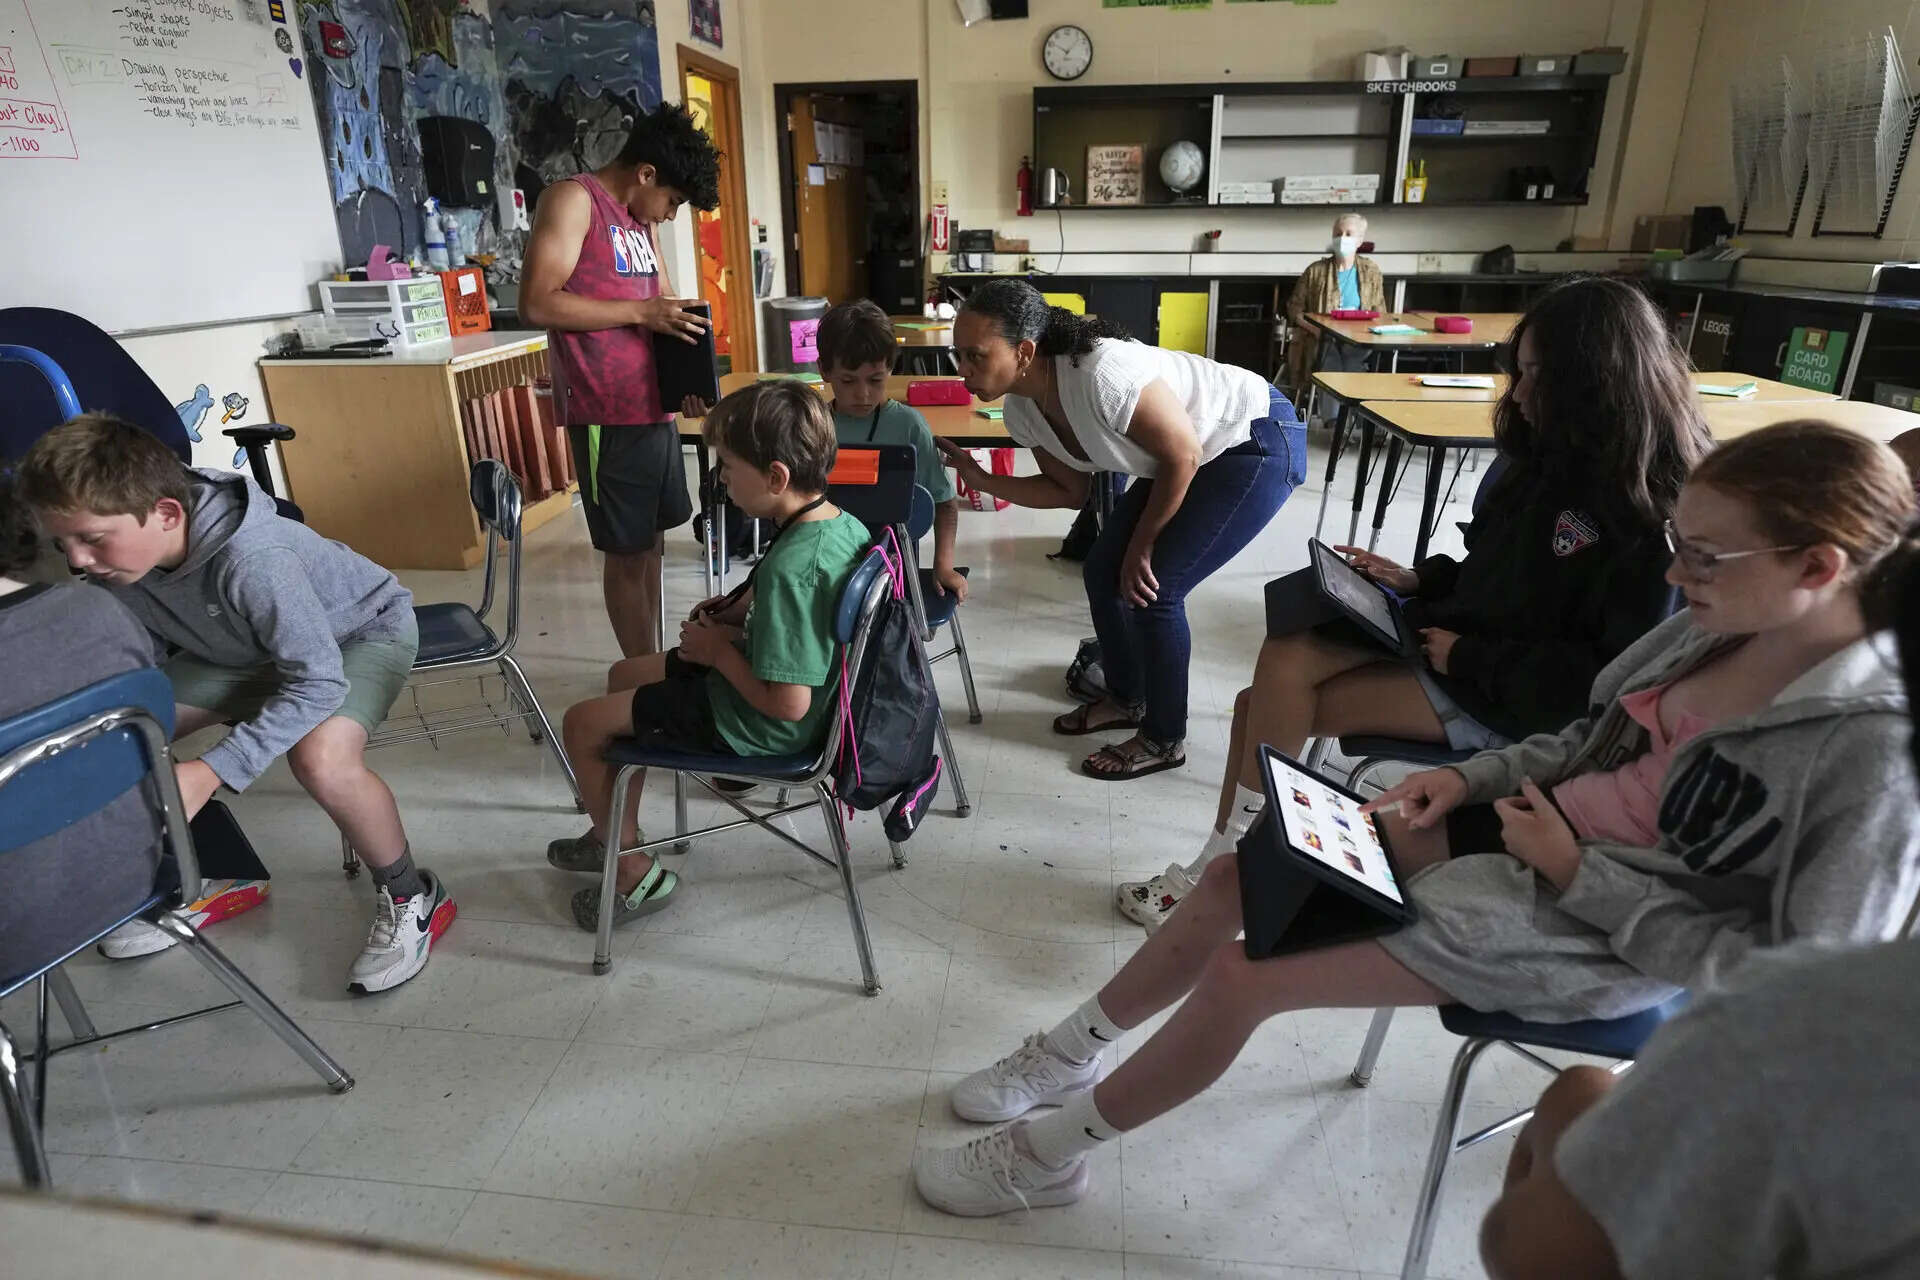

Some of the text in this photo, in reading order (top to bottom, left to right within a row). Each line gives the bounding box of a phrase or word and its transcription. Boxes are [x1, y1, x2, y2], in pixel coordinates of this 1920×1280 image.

[121, 58, 230, 86] Drawing perspective
[1366, 81, 1457, 94] SKETCHBOOKS
[25, 106, 59, 134] Clay
[625, 230, 659, 273] NBA
[1702, 319, 1730, 336] LEGOS
[1793, 350, 1829, 369] CARD
[1787, 365, 1832, 387] BOARD
